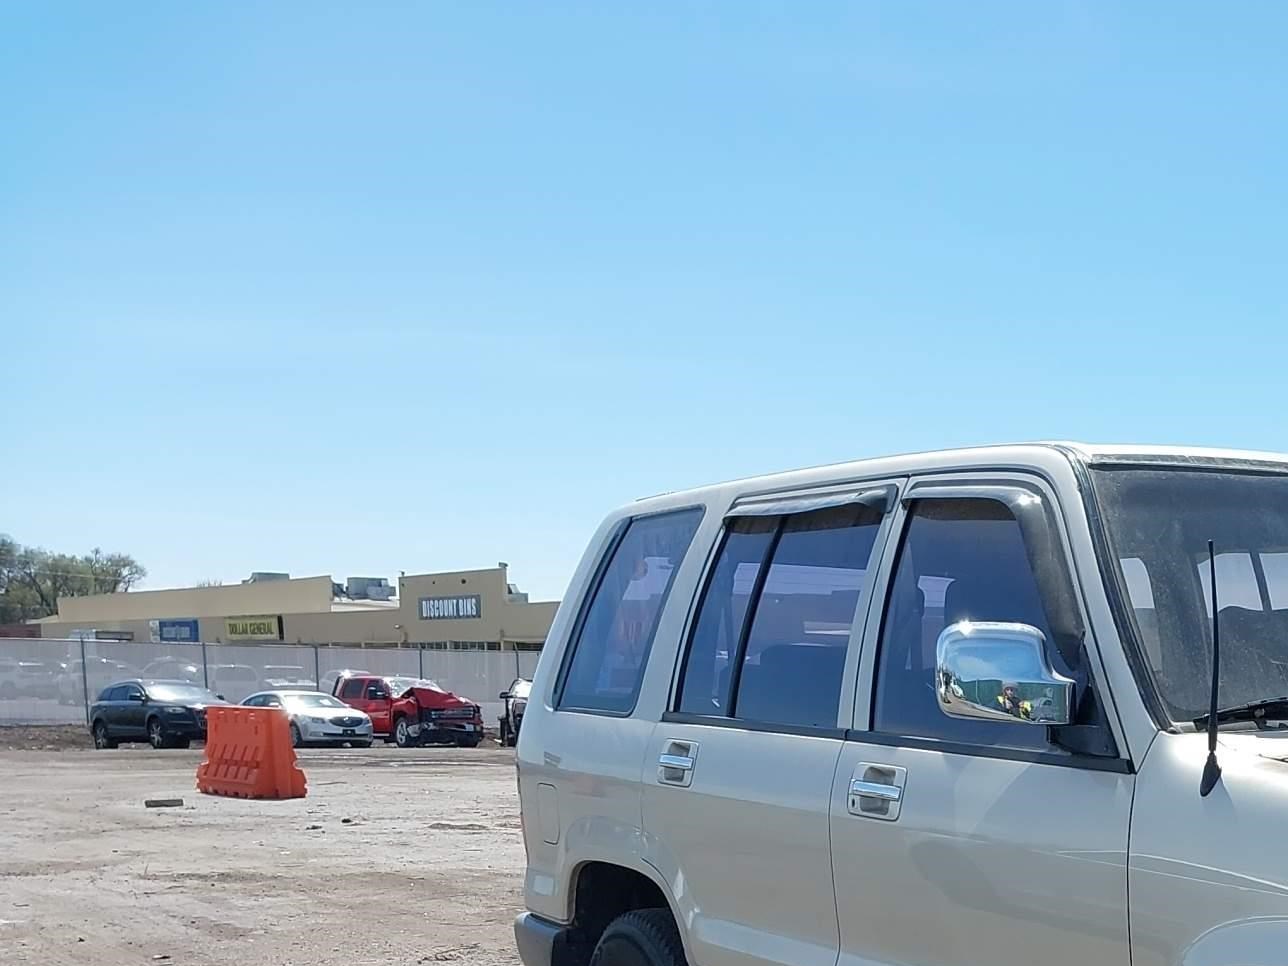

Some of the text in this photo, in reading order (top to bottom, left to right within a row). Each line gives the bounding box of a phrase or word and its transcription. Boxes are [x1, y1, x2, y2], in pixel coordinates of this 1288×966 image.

[422, 598, 477, 617] DISCOUNT BINS
[228, 622, 275, 635] DOLLAR GENERAL
